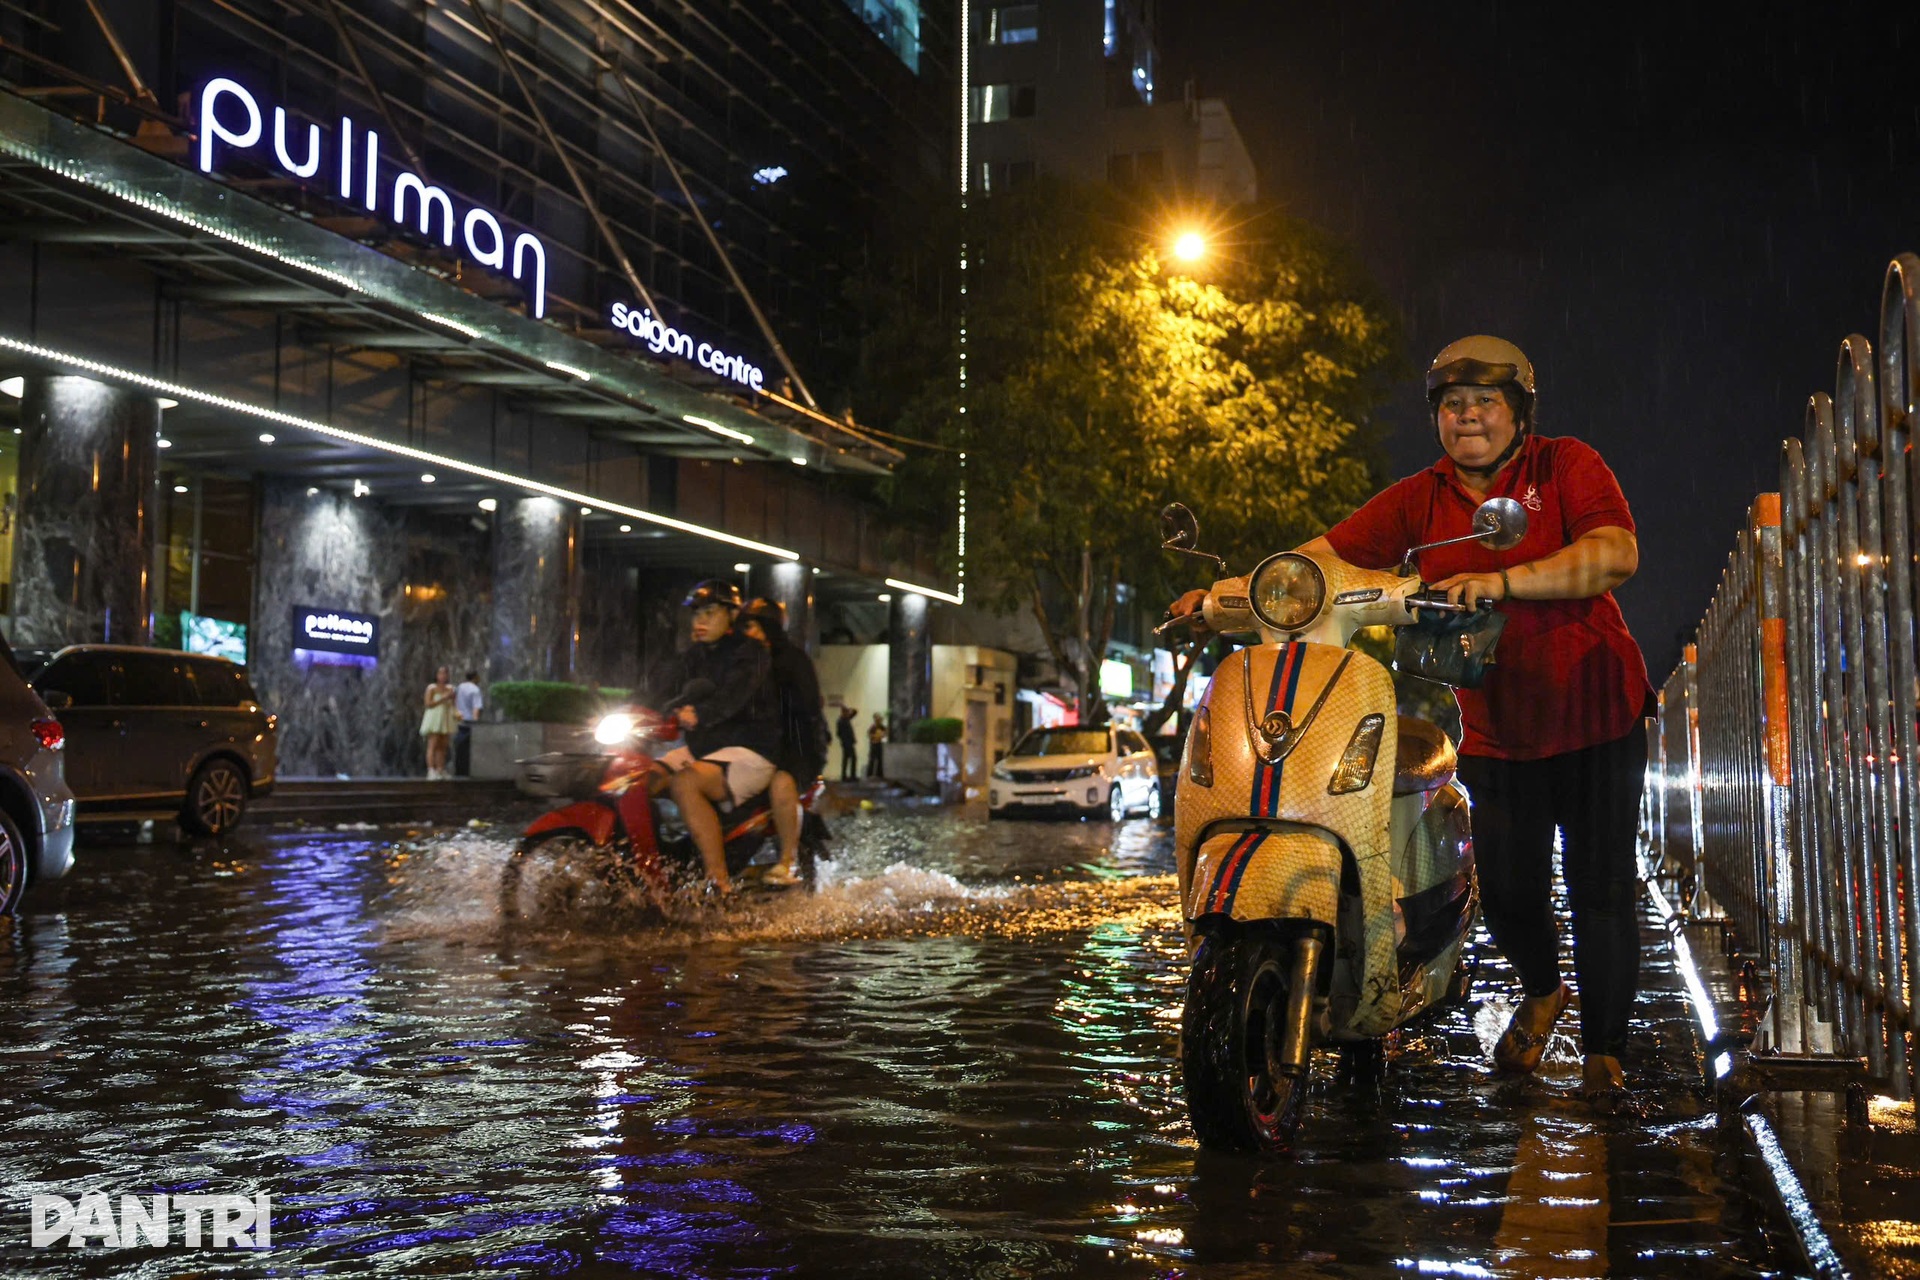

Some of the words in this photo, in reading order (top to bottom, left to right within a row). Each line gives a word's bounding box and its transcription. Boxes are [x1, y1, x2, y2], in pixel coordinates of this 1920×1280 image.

[199, 77, 547, 319] pullman
[611, 302, 694, 360] saigon
[697, 342, 764, 391] centre
[305, 613, 373, 639] pullman
